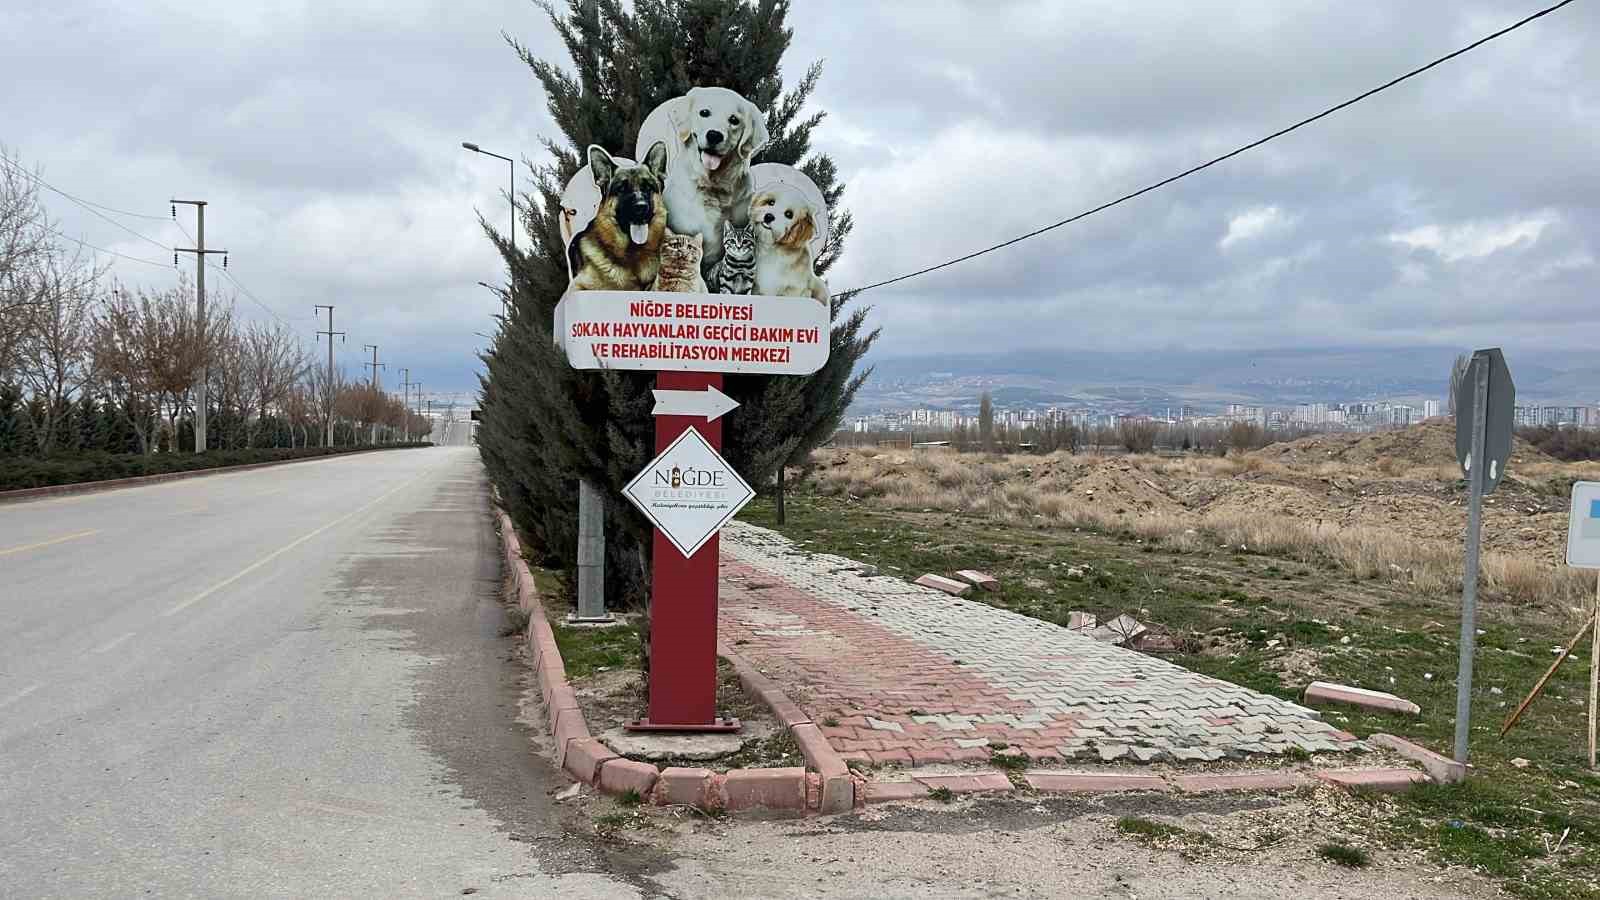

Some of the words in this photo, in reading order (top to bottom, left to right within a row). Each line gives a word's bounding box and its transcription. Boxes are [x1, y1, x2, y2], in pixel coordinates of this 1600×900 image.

[630, 301, 672, 319] NİĞDE
[675, 303, 753, 321] BELEDİYESİ
[571, 322, 609, 338] SOKAK
[613, 324, 699, 340] HAYVANLARI
[703, 324, 747, 343] GEÇİCİ
[750, 328, 793, 343] BAKIM
[796, 327, 819, 344] EVİ
[591, 343, 608, 358] VE
[612, 342, 728, 360] REHABİLİTASYON
[732, 346, 790, 363] MERKEZİ
